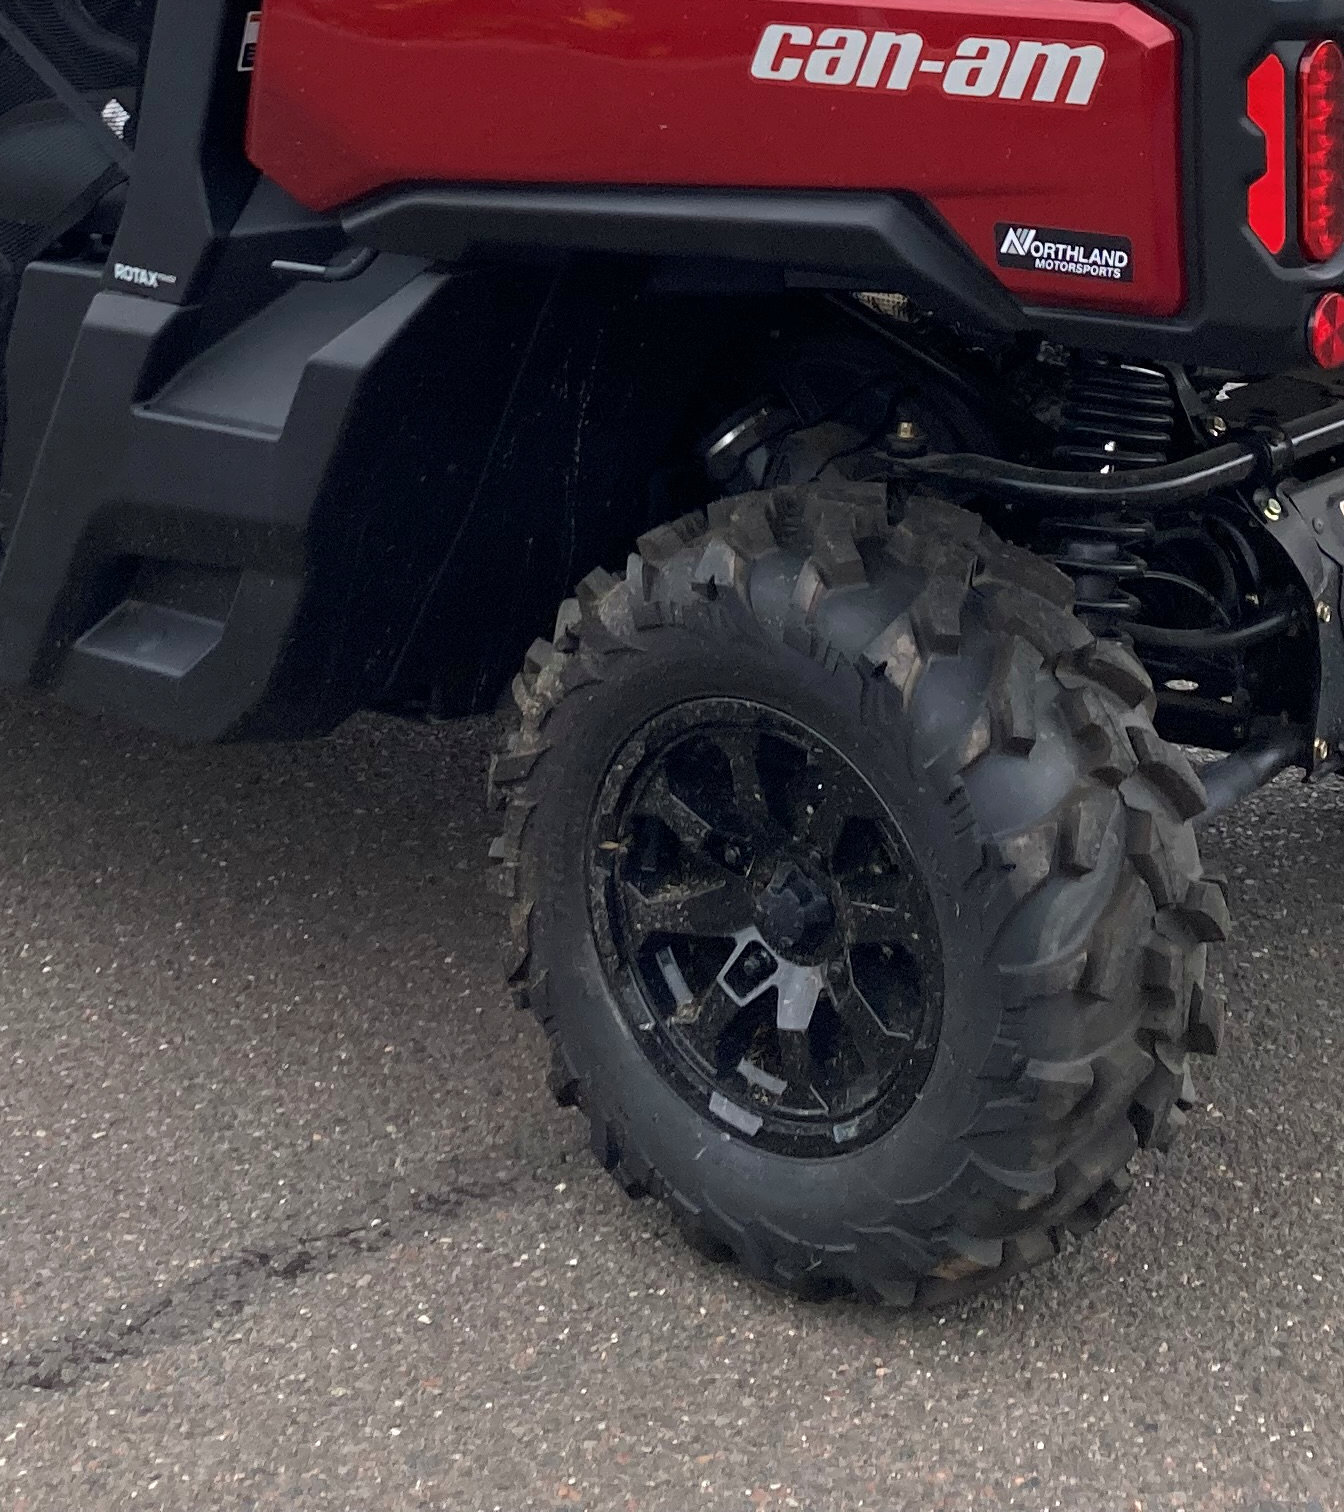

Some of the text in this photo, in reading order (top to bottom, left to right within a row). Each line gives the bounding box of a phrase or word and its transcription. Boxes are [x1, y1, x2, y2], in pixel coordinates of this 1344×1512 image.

[751, 24, 1105, 105] can-am
[1000, 227, 1128, 268] NORTHLAND
[114, 263, 158, 288] ROTAX
[1035, 258, 1121, 279] MOTORSPORTS
